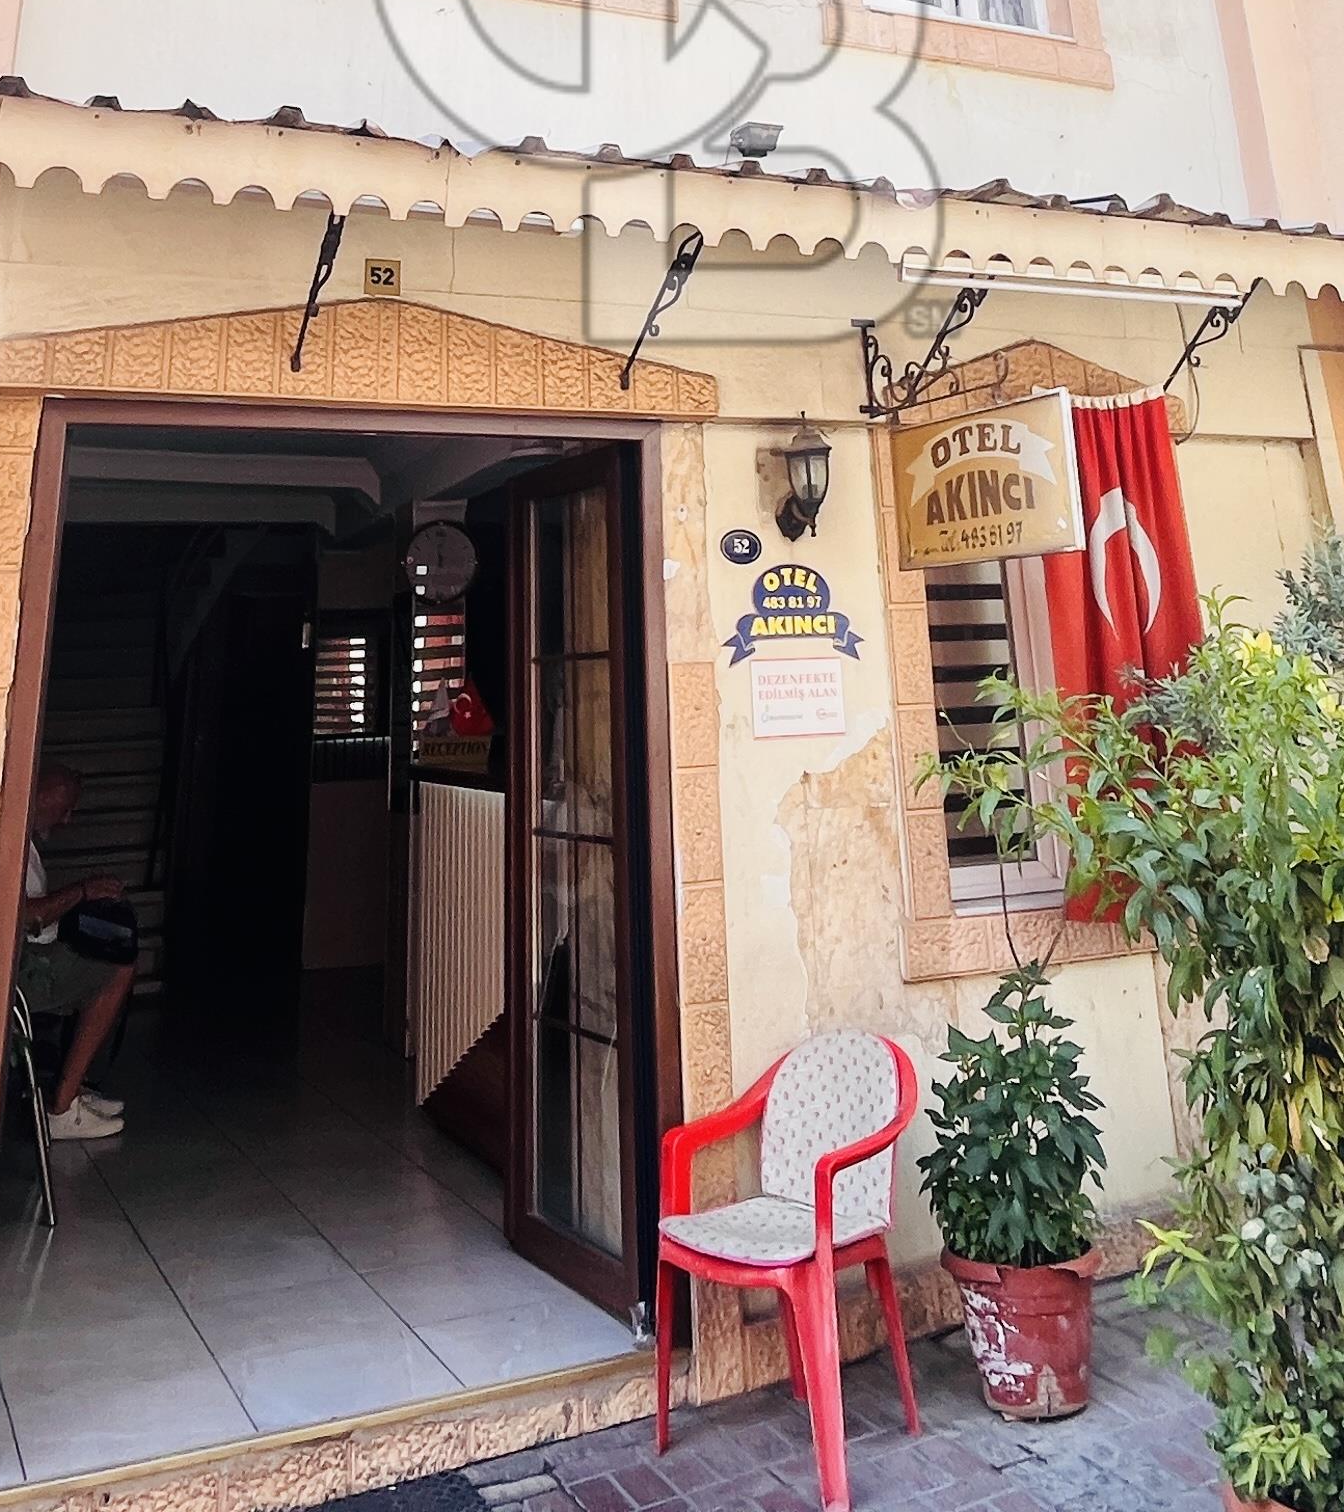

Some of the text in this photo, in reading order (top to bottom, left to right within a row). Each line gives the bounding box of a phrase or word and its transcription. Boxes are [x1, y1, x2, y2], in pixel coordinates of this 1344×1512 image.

[370, 266, 395, 286] 52
[930, 422, 1021, 469] OTEL
[926, 468, 1036, 527] AKINCI
[733, 538, 750, 554] 52
[762, 567, 818, 594] OTEL
[762, 595, 823, 610] 483 81 97
[750, 614, 836, 637] AKINCI
[758, 672, 836, 686] DEZENFEKTE
[808, 687, 838, 698] ALAN
